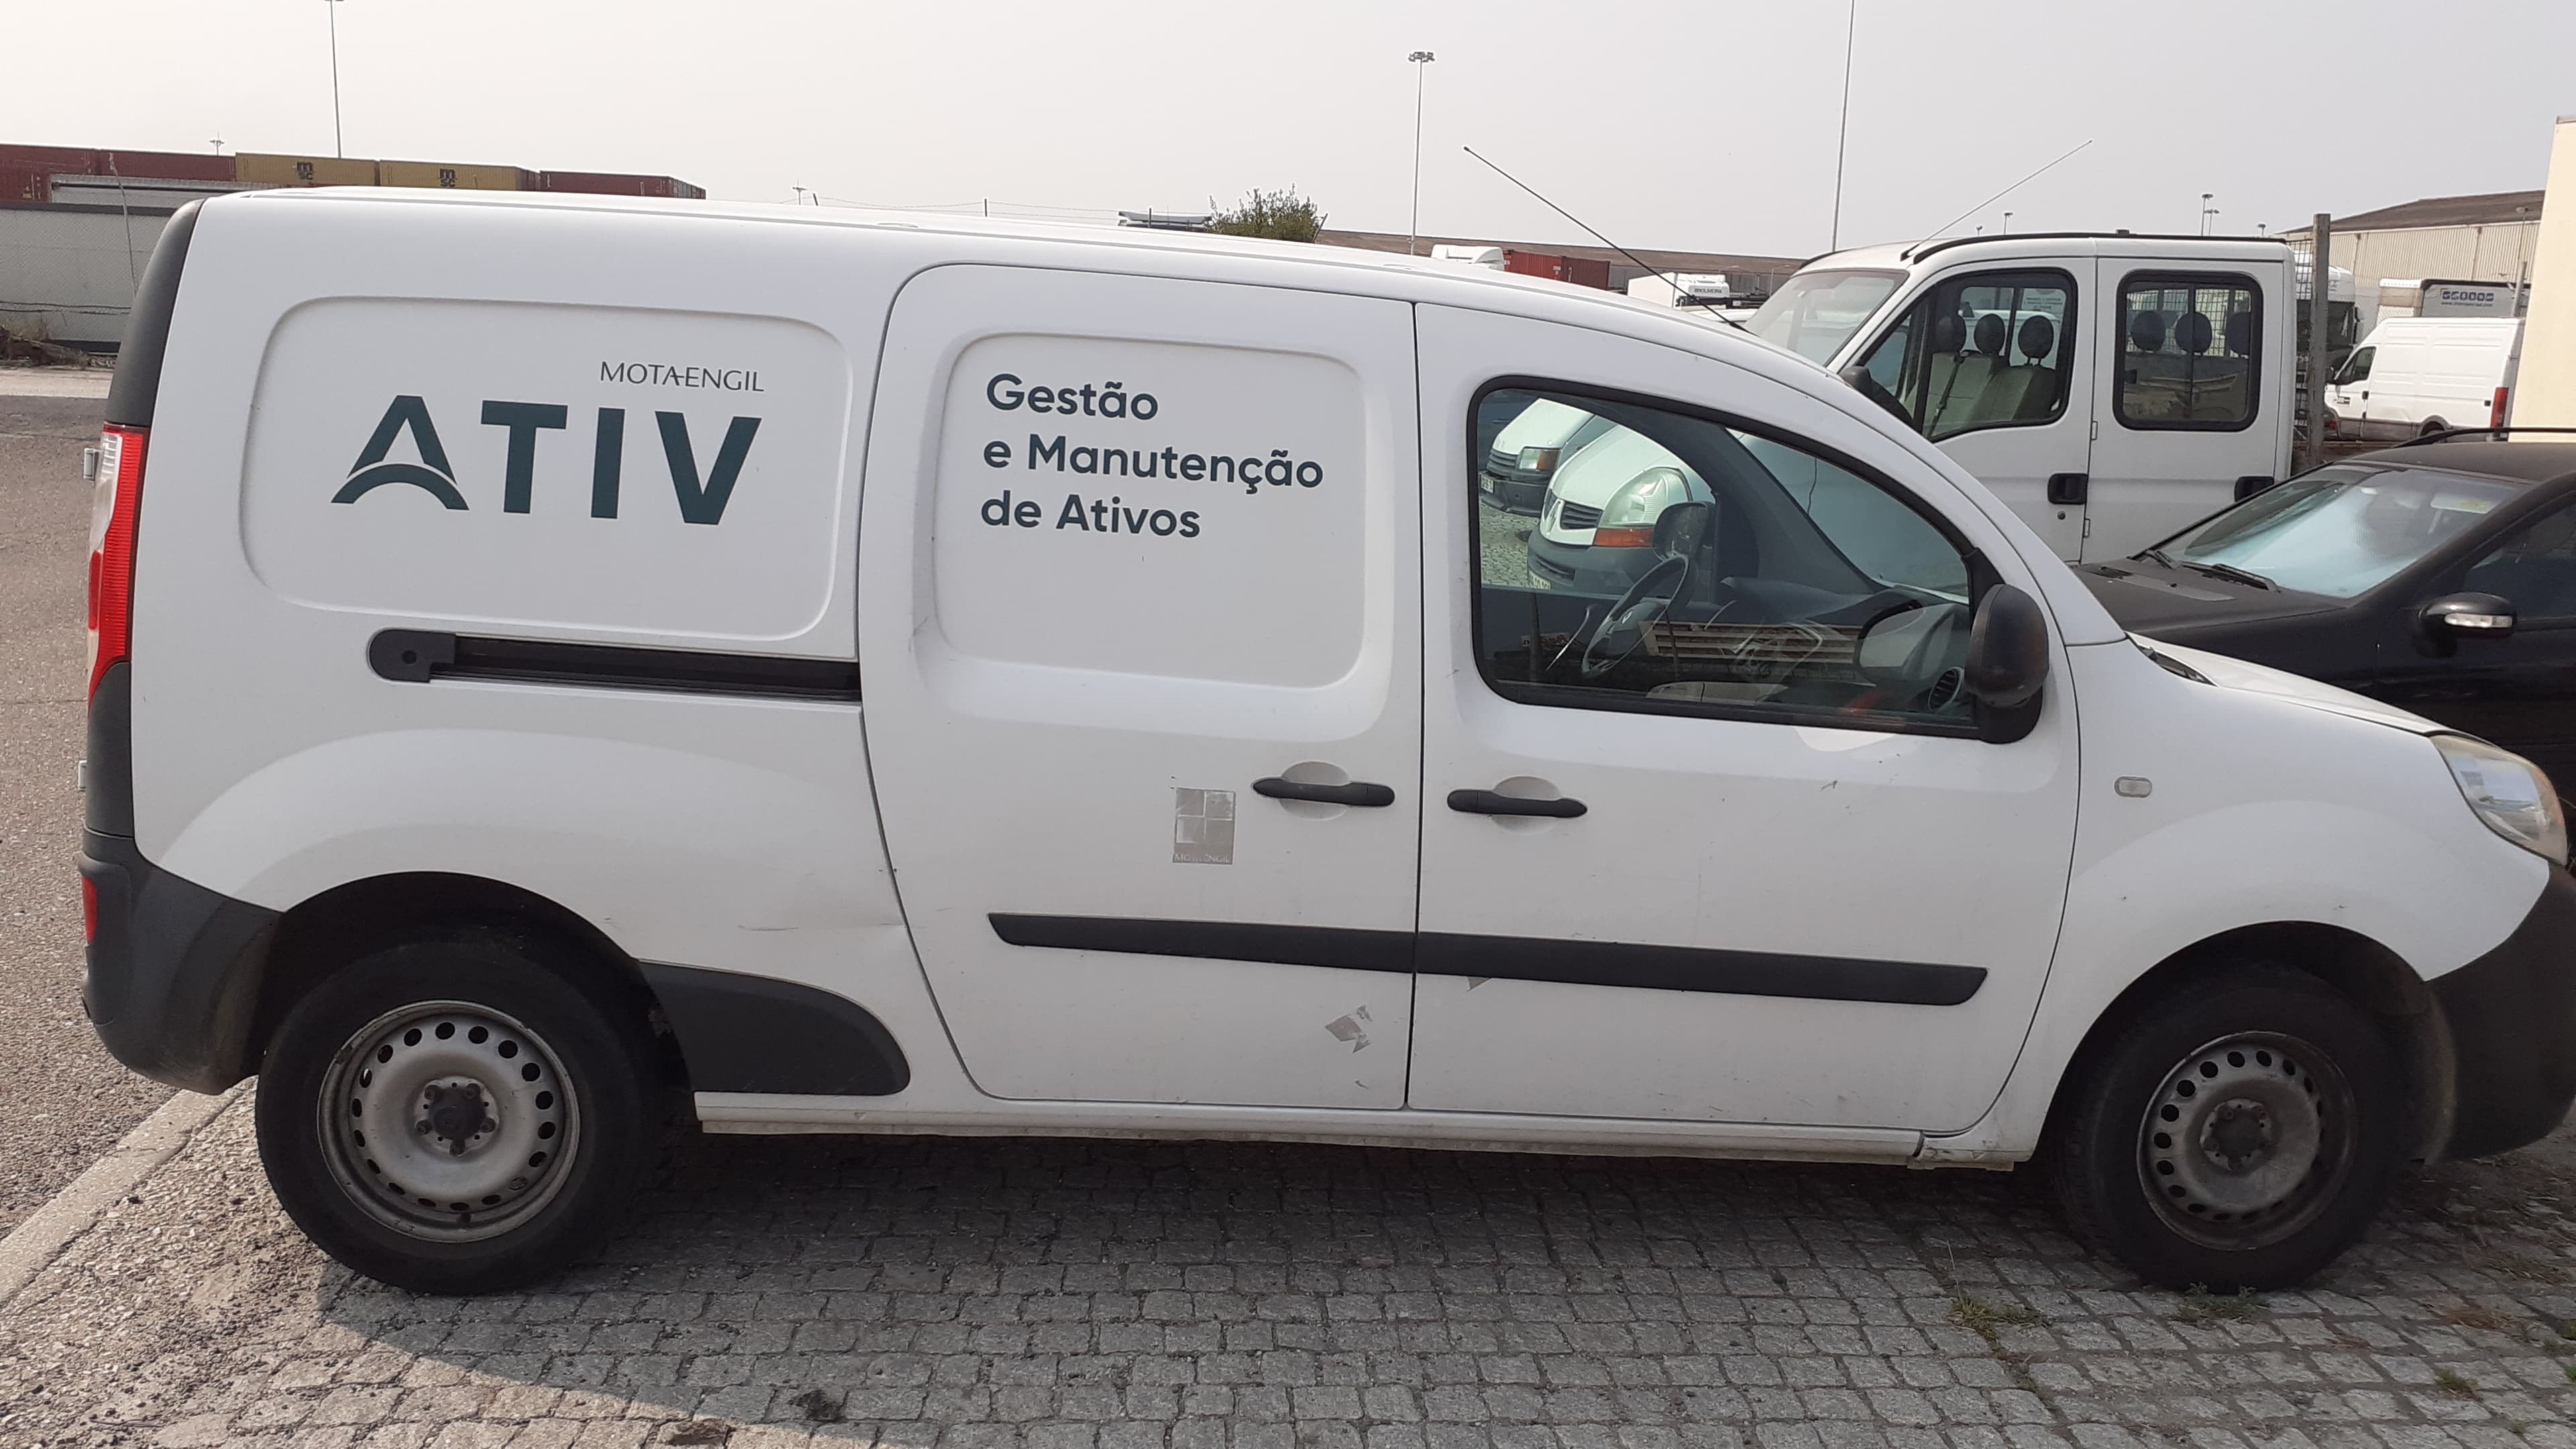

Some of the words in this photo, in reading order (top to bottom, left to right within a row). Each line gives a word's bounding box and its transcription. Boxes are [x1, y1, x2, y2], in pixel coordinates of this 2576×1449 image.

[987, 373, 1159, 421] Gestão
[331, 394, 762, 525] ATIV
[983, 441, 1012, 468] e
[1028, 433, 1324, 494] Manutenção
[981, 490, 1042, 528] de
[1056, 494, 1200, 538] Ativos
